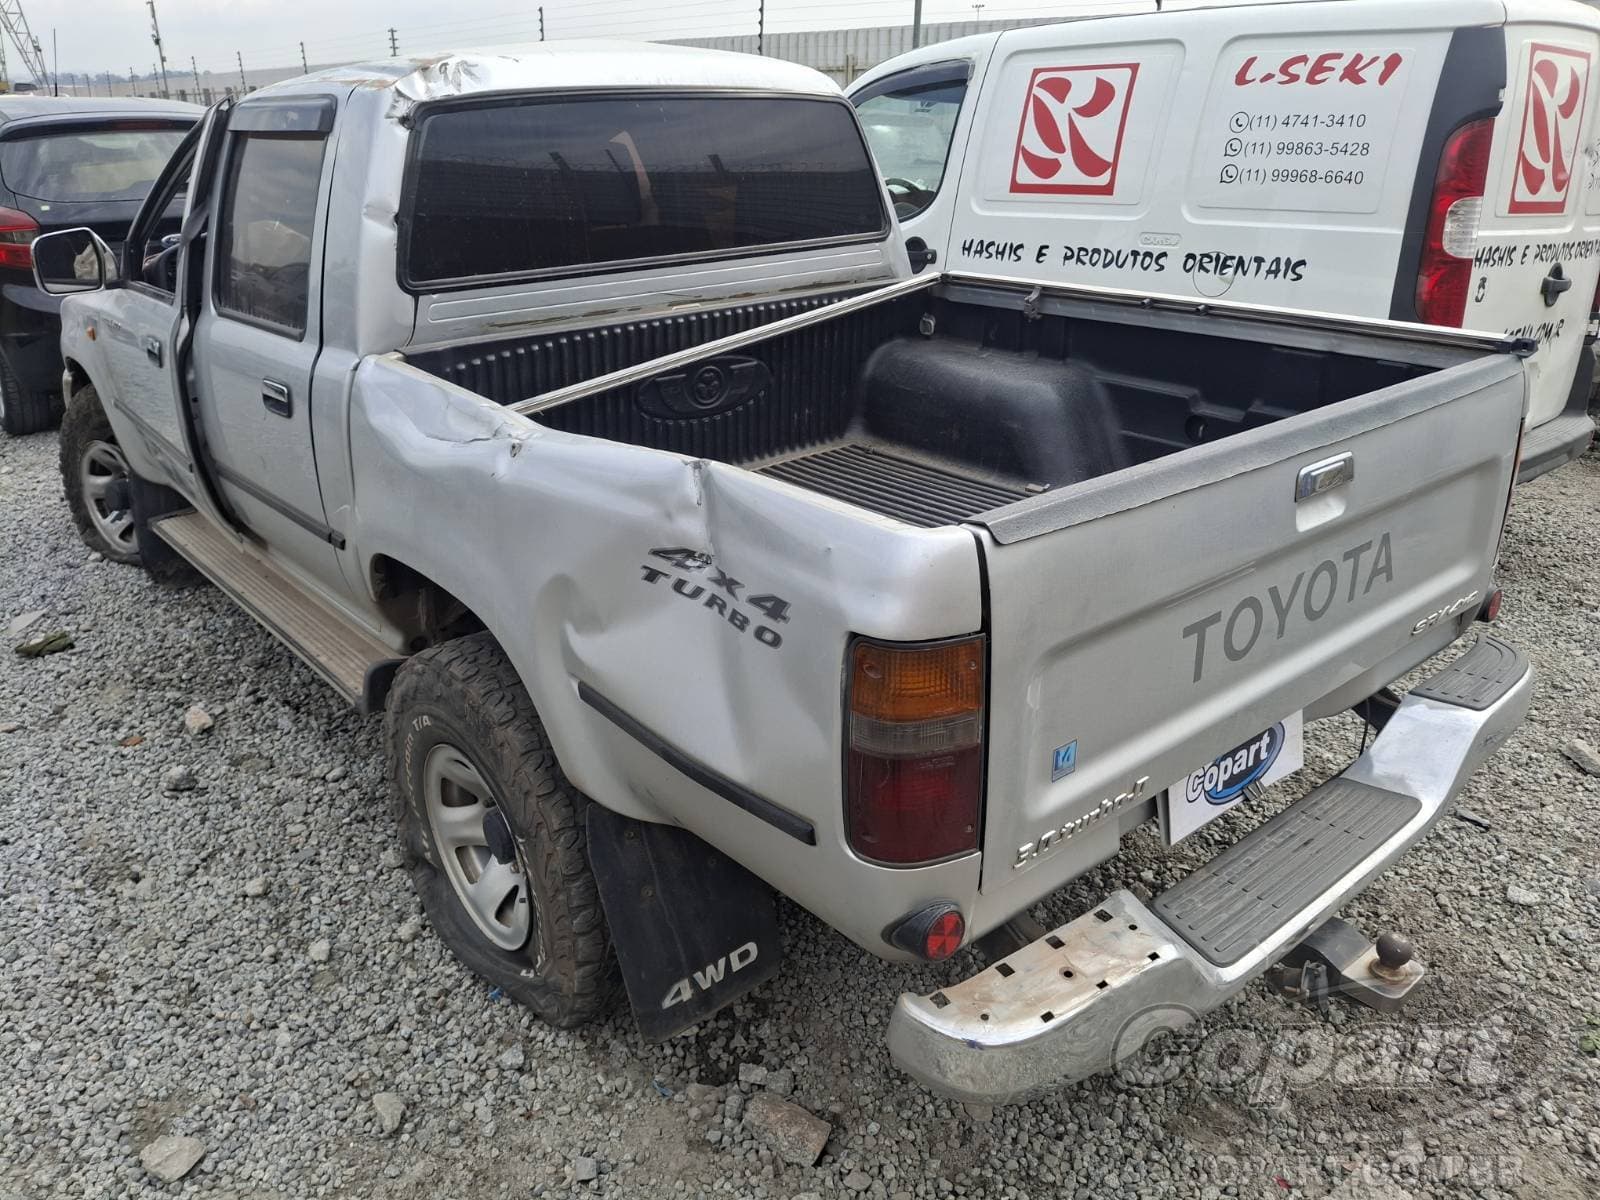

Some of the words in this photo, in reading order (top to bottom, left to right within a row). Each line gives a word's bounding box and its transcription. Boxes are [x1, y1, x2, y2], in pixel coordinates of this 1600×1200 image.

[1235, 53, 1402, 86] L.SEKI
[1249, 114, 1278, 131] (11)
[1281, 114, 1366, 128] 4741-3410
[1243, 141, 1272, 158] (11)
[1276, 141, 1370, 156] 99863-5428
[1239, 168, 1267, 185] (11)
[1271, 168, 1364, 185] 99968-6640
[961, 238, 1024, 262] HASHIS
[1035, 244, 1050, 263] E
[1062, 245, 1168, 272] PRODUTOS
[1182, 252, 1308, 282] ORIENTAIS
[1474, 245, 1517, 269] HASHIS
[1520, 244, 1530, 265] E
[1533, 241, 1575, 264] PRODUTOS
[641, 565, 783, 649] TURBO
[1182, 532, 1393, 683] TOYOTA
[1186, 729, 1271, 803] Copart
[661, 941, 759, 1010] 4WD
